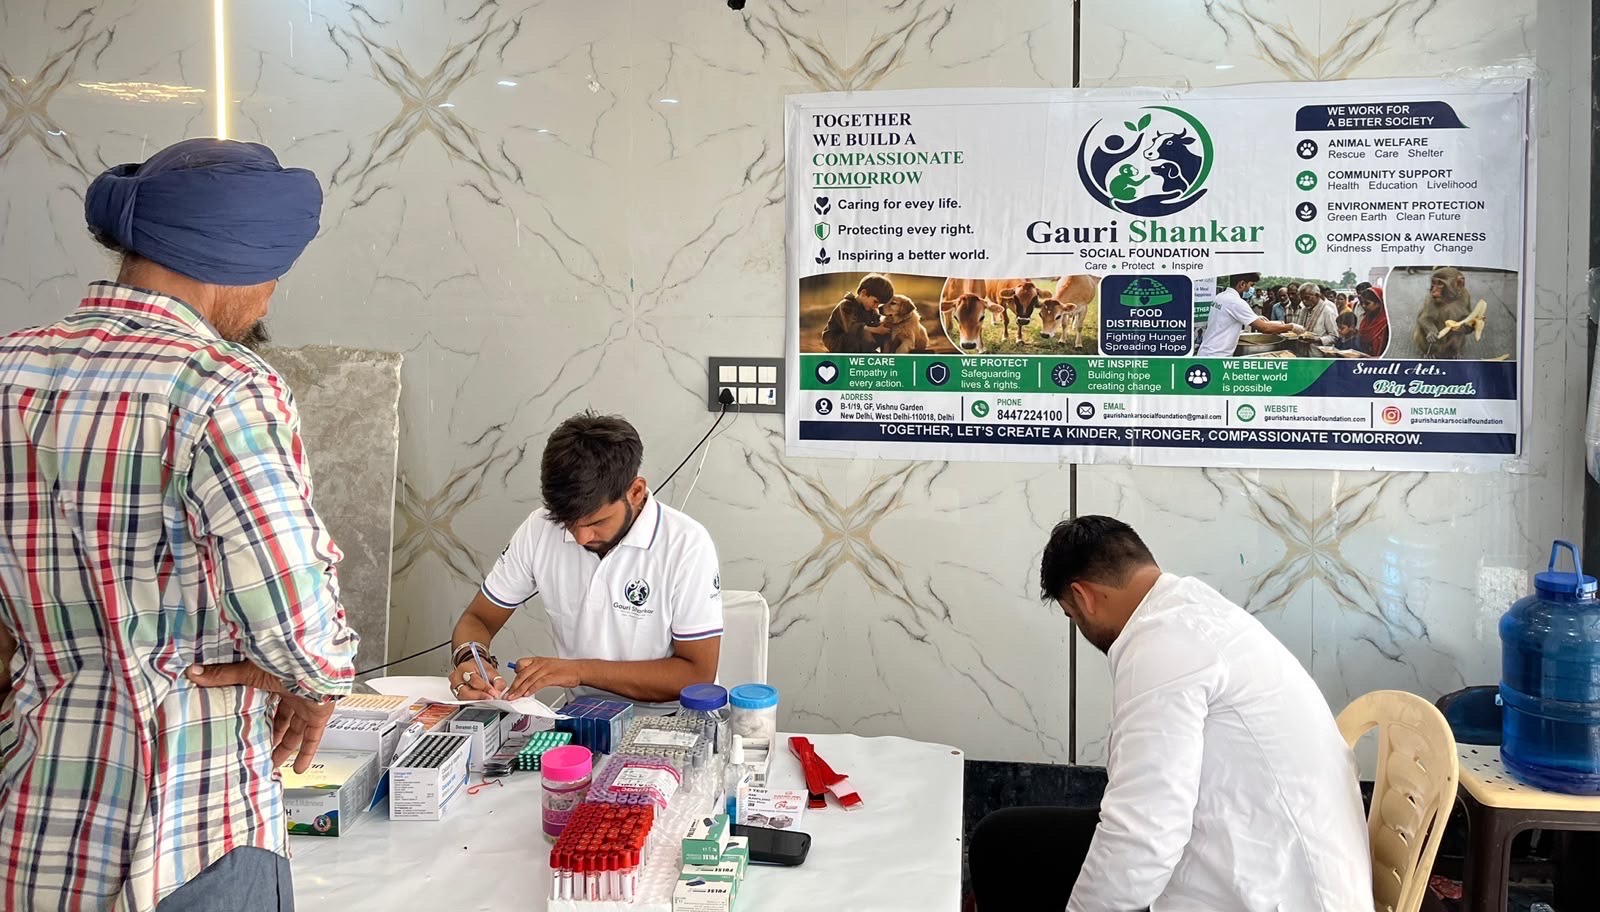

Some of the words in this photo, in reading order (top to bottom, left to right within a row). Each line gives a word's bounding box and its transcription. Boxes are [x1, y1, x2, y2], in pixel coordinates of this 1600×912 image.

[1327, 107, 1346, 116] WE
[1348, 106, 1384, 115] WORK
[1386, 106, 1410, 114] FOR
[813, 112, 912, 128] TOGETHER
[1327, 119, 1335, 127] A
[1338, 118, 1382, 127] BETTER
[1385, 116, 1434, 126] SOCIETY
[813, 134, 840, 147] WE
[846, 133, 900, 146] BUILD
[904, 132, 916, 146] A
[1328, 139, 1371, 148] ANIMAL
[1374, 138, 1428, 147] WELFARE
[813, 151, 964, 166] COMPASSIONATE
[1328, 150, 1365, 158] Rescue
[1375, 150, 1399, 158] Care
[1408, 149, 1444, 158] Shelter
[813, 171, 923, 186] TOMORROW
[1328, 170, 1395, 179] COMMUNITY
[1398, 170, 1452, 178] SUPPORT
[1328, 181, 1359, 190] Health
[1368, 181, 1418, 189] Education
[1427, 180, 1478, 189] Livelihood
[838, 199, 879, 212] Caring
[883, 199, 901, 209] for
[904, 200, 935, 212] evey
[938, 198, 961, 208] life.
[1327, 202, 1408, 211] ENVIRONMENT
[1412, 201, 1485, 210] PROTECTION
[1327, 213, 1358, 222] Green
[1361, 213, 1387, 221] Earth
[1396, 212, 1425, 221] Clean
[1429, 212, 1461, 221] Future
[838, 224, 904, 237] Protecting
[907, 226, 936, 237] evey
[940, 224, 974, 236] right.
[1026, 220, 1118, 244] Gauri
[1129, 220, 1264, 243] Shankar
[1327, 233, 1400, 242] COMPASSION
[1404, 233, 1412, 242] &
[1415, 233, 1486, 242] AWARENESS
[1080, 249, 1125, 258] SOCIAL
[1129, 248, 1210, 258] FOUNDATION
[1327, 244, 1372, 253] Kindness
[1381, 244, 1425, 254] Empathy
[1434, 244, 1473, 254] Change
[838, 250, 894, 263] Inspiring
[908, 249, 945, 260] better
[949, 249, 989, 260] world.
[1122, 262, 1155, 270] Protect
[1172, 262, 1204, 272] Inspire
[1130, 309, 1162, 317] FOOD
[1106, 320, 1186, 328] DISTRIBUTION
[1106, 333, 1145, 342] Fighting
[1149, 333, 1186, 342] Hunger
[1106, 343, 1157, 352] Spreading
[1160, 343, 1186, 352] Hope
[849, 358, 865, 366] WE
[867, 358, 894, 366] CARE
[961, 359, 978, 367] WE
[981, 359, 1028, 367] PROTECT
[1108, 360, 1148, 368] INSPIRE
[1223, 361, 1240, 369] WE
[1243, 361, 1288, 370] BELIEVE
[850, 368, 887, 378] Empathy
[1353, 362, 1399, 375] Small
[1405, 363, 1446, 376] Acts.
[961, 369, 1020, 380] Safeguarding
[1088, 371, 1124, 380] Building
[1127, 372, 1150, 381] hope
[1232, 372, 1259, 381] better
[1261, 373, 1287, 381] world
[850, 380, 872, 388] every
[875, 379, 904, 388] action.
[961, 381, 982, 389] lives
[993, 381, 1020, 390] rights.
[1088, 383, 1125, 392] creating
[1127, 383, 1161, 392] change
[1233, 384, 1272, 393] possible
[1373, 380, 1405, 396] Big
[1409, 380, 1476, 397] Impact.
[840, 403, 862, 411] B-1/19,
[856, 413, 873, 421] Delhi,
[997, 409, 1062, 421] 8447224100
[880, 424, 953, 437] TOGETHER,
[957, 426, 993, 437] LET’S
[997, 426, 1050, 438] CREATE
[1053, 428, 1062, 438] A
[1067, 428, 1120, 440] KINDER,
[1125, 429, 1204, 442] STRONGER,
[1209, 431, 1328, 443] COMPASSIONATE
[1333, 433, 1423, 445] TOMORROW.
[613, 602, 631, 610] Gauri
